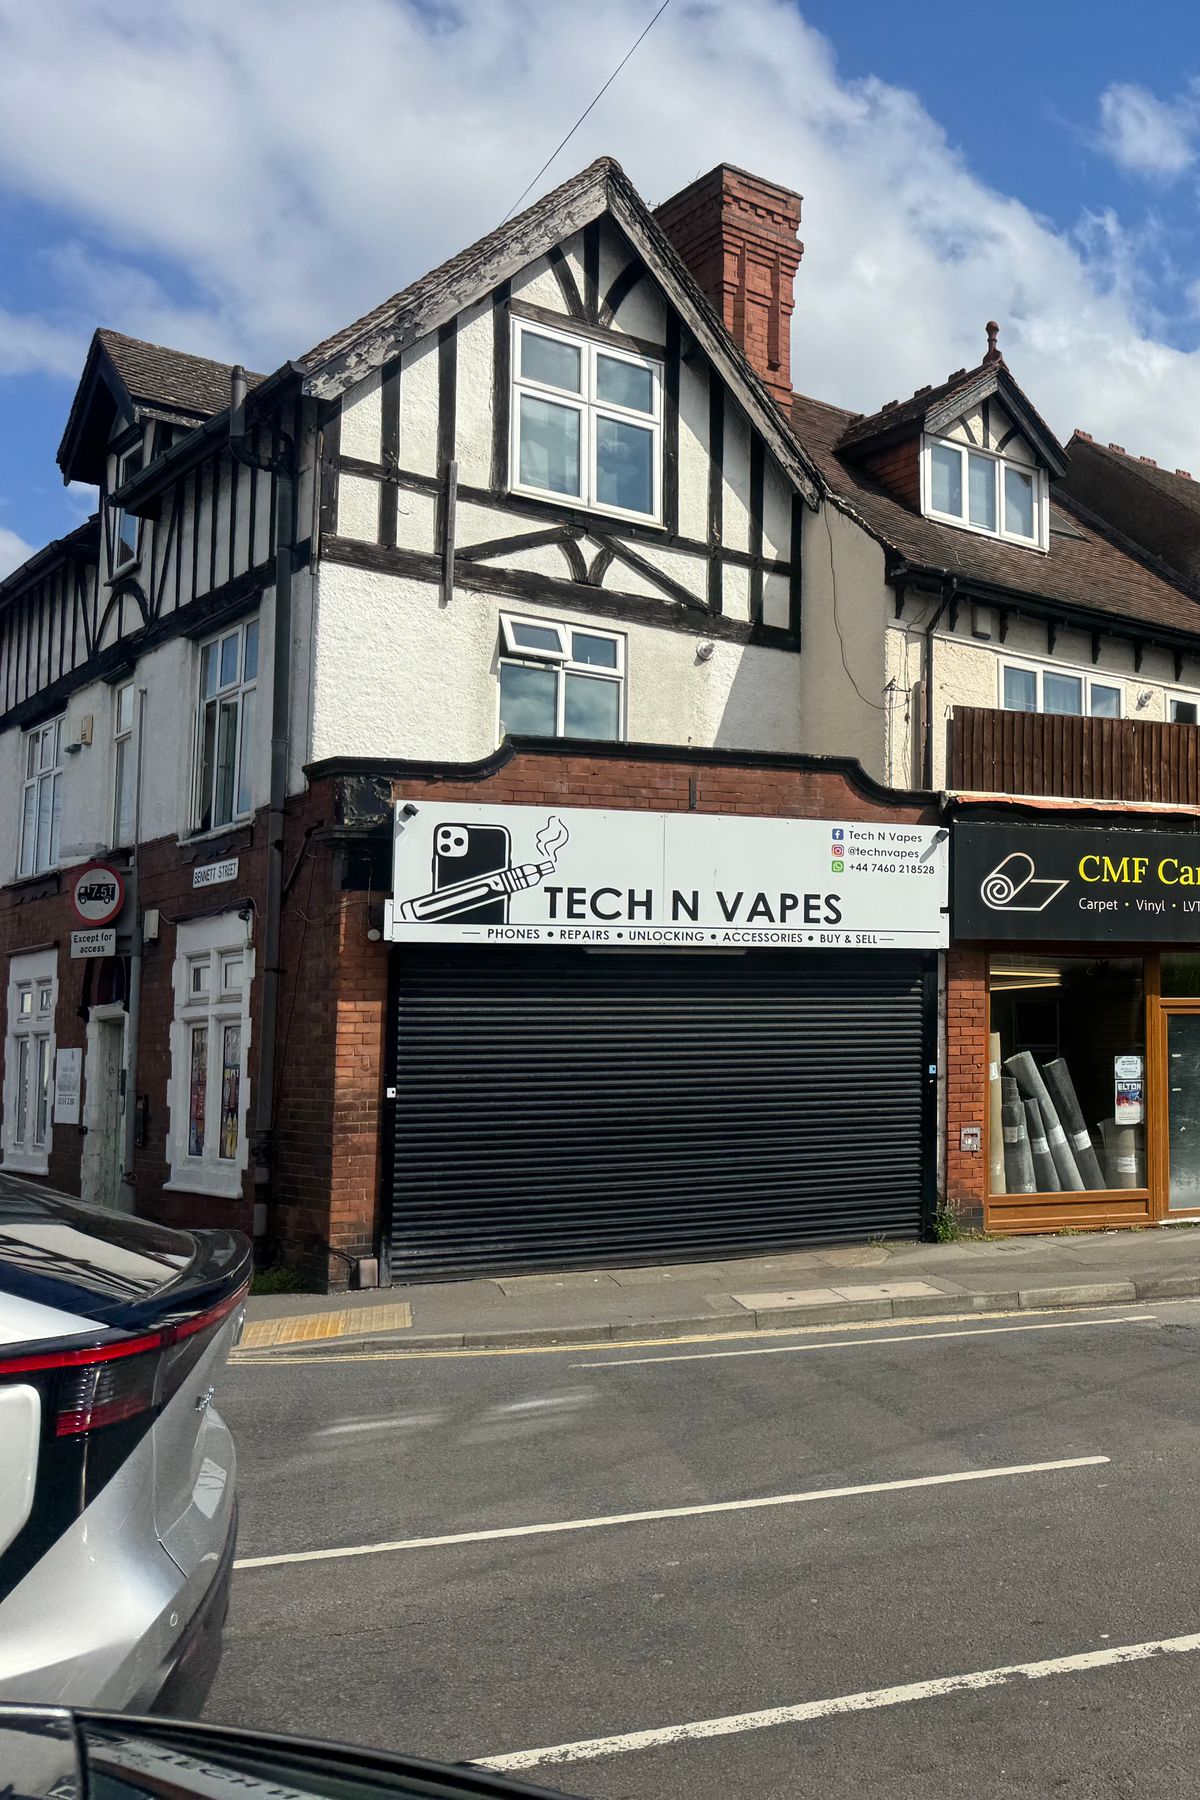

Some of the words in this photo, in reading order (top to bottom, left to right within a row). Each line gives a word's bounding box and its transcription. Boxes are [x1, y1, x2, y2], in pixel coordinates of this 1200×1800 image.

[849, 831, 874, 840] Tech
[878, 832, 885, 840] N
[889, 832, 922, 843] Vapes
[848, 846, 919, 859] @technvapes
[194, 868, 215, 885] BENNETT
[218, 863, 237, 878] STREET
[849, 863, 868, 872] +44
[871, 863, 896, 873] 7460
[899, 864, 935, 874] 218528
[1078, 855, 1149, 883] CMF
[90, 884, 115, 898] 7.5T
[544, 886, 653, 921] TECH
[672, 889, 699, 921] N
[716, 891, 843, 925] VAPES
[1078, 897, 1118, 913] Carpet
[1136, 899, 1166, 914] Vinyl
[73, 933, 99, 944] Except
[101, 932, 112, 942] for
[487, 929, 540, 939] PHONES
[560, 929, 610, 940] REPAIRS
[629, 930, 705, 941] UNLOCKING
[722, 932, 803, 943] ACCESSORIES
[820, 934, 841, 944] BUY
[845, 934, 851, 944] &
[855, 935, 877, 944] SELL
[80, 944, 105, 954] access
[1117, 1082, 1142, 1091] ELTON
